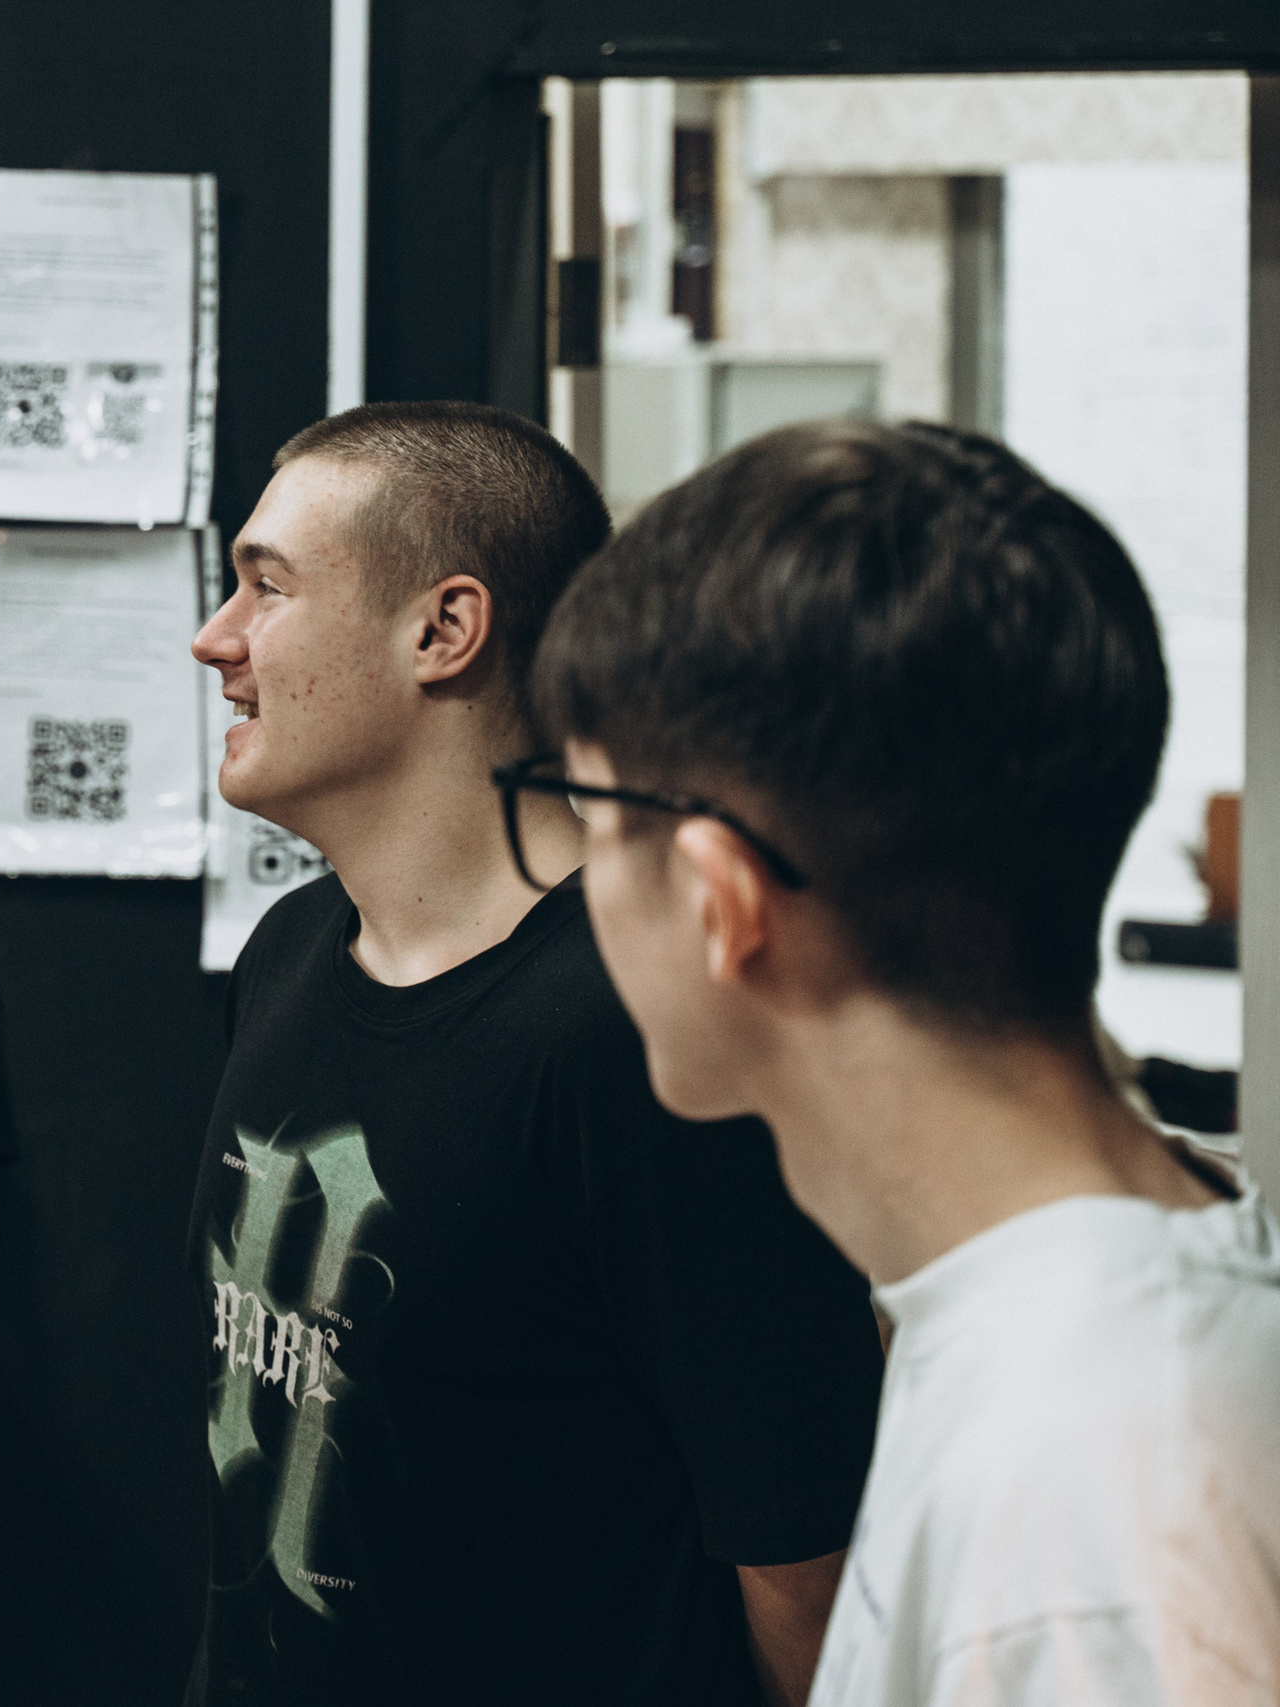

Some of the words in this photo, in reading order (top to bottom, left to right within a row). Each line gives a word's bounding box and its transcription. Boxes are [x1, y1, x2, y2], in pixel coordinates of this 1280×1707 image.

[324, 1306, 341, 1323] NOT
[341, 1316, 353, 1330] SO
[213, 1280, 341, 1410] RARE
[296, 1567, 357, 1592] DIVERSITY
